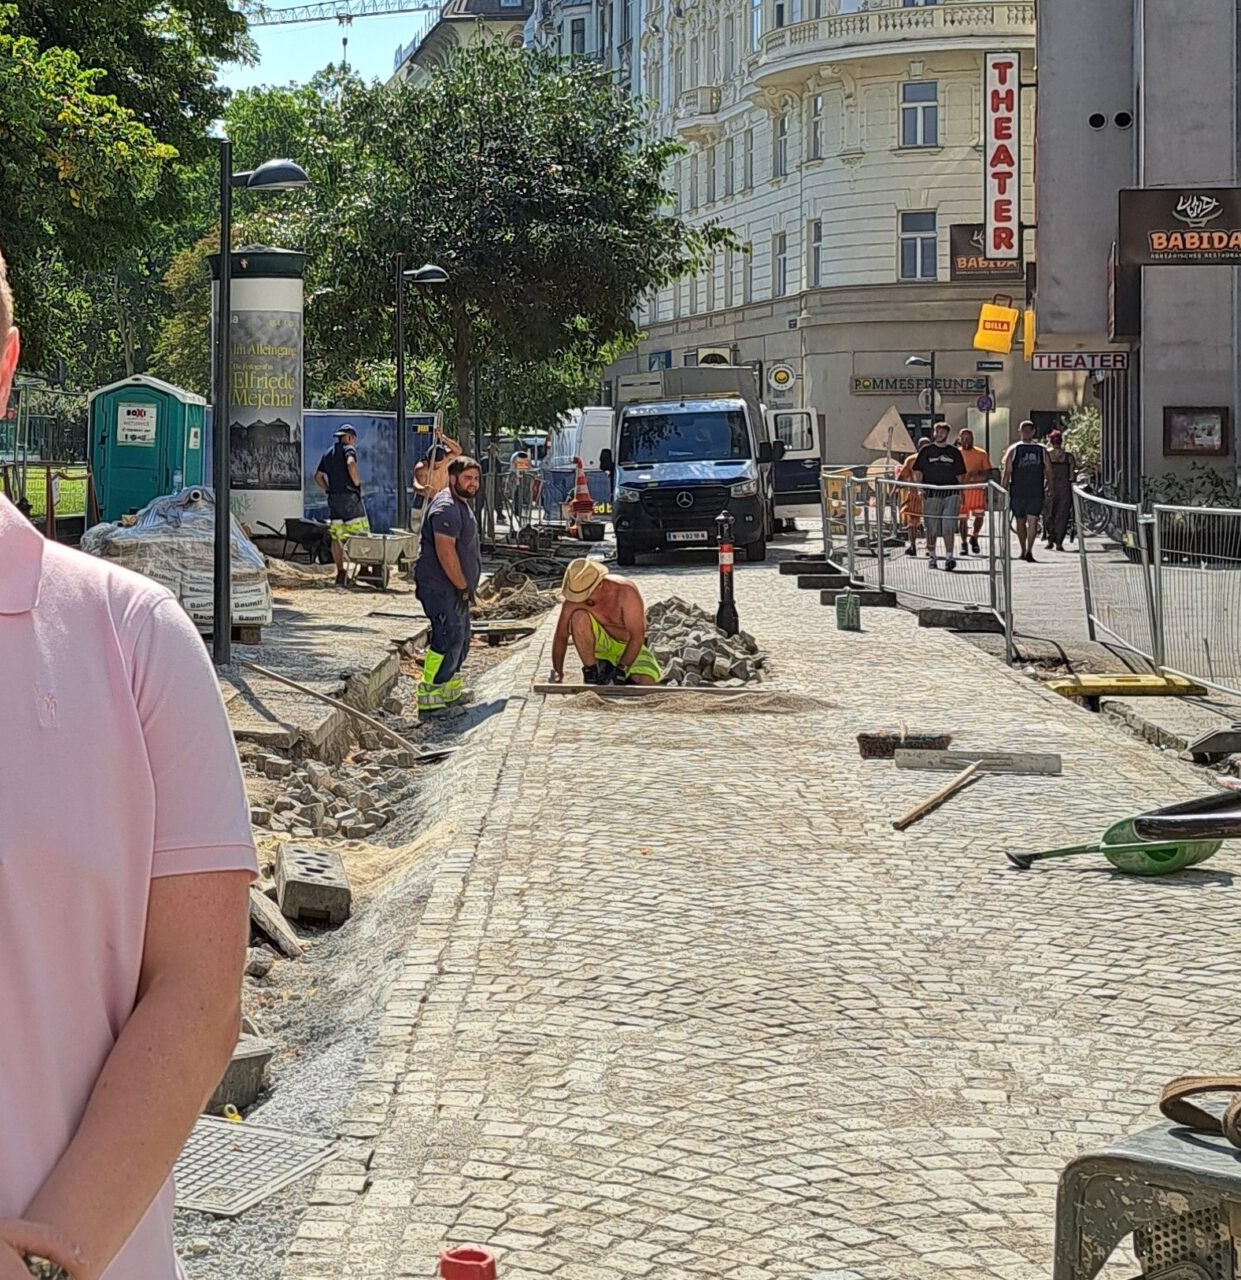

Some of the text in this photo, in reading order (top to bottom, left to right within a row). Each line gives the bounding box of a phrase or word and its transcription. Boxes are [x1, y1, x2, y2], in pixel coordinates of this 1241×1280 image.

[989, 61, 1015, 251] THEATER
[1149, 231, 1241, 250] BABIDA
[984, 321, 1009, 331] BILLA
[1035, 354, 1125, 368] THEATER
[233, 371, 295, 390] Elfriede
[232, 389, 294, 409] Mejchar
